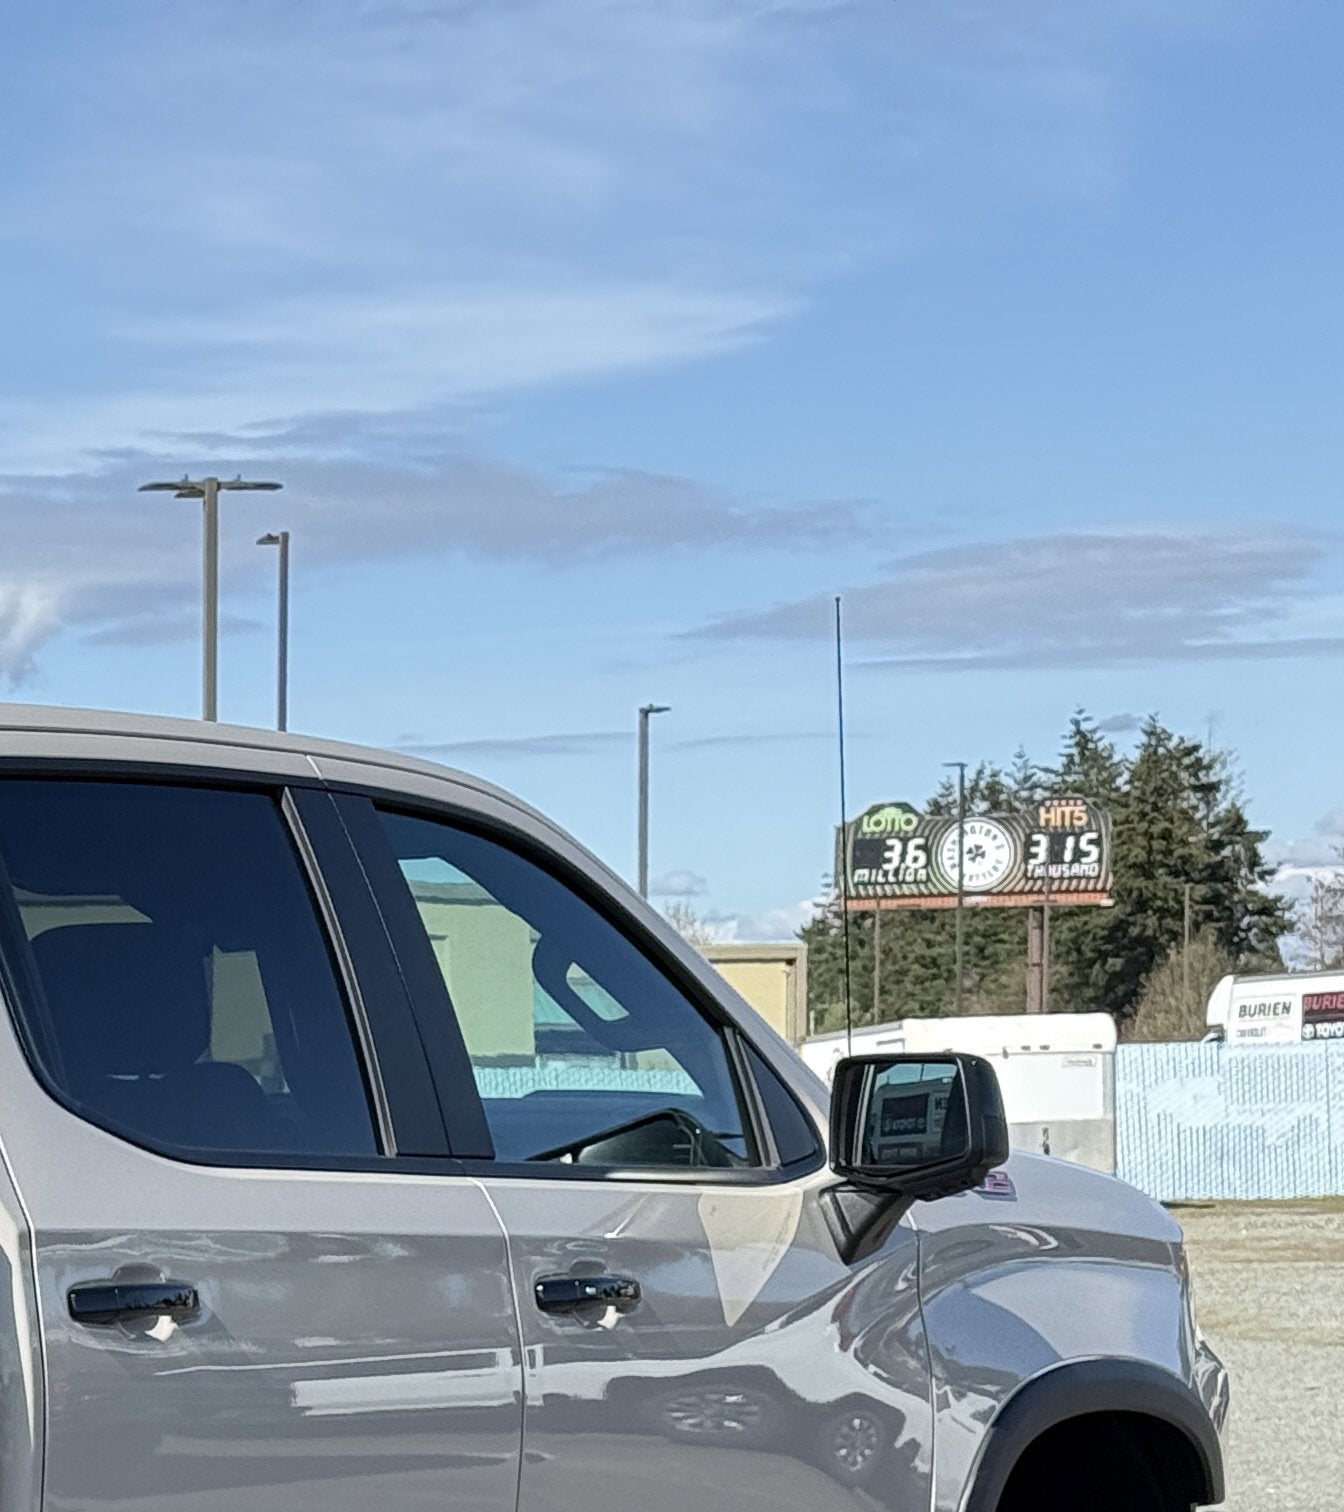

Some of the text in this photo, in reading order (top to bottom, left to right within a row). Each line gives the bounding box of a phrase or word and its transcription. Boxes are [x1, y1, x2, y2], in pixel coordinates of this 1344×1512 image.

[862, 806, 918, 833] LOTTO
[882, 837, 927, 869] 36
[853, 864, 927, 883] MILLION
[1238, 1001, 1292, 1018] BURIEN
[1303, 993, 1344, 1011] BURIE
[1316, 1021, 1344, 1038] TOYO
